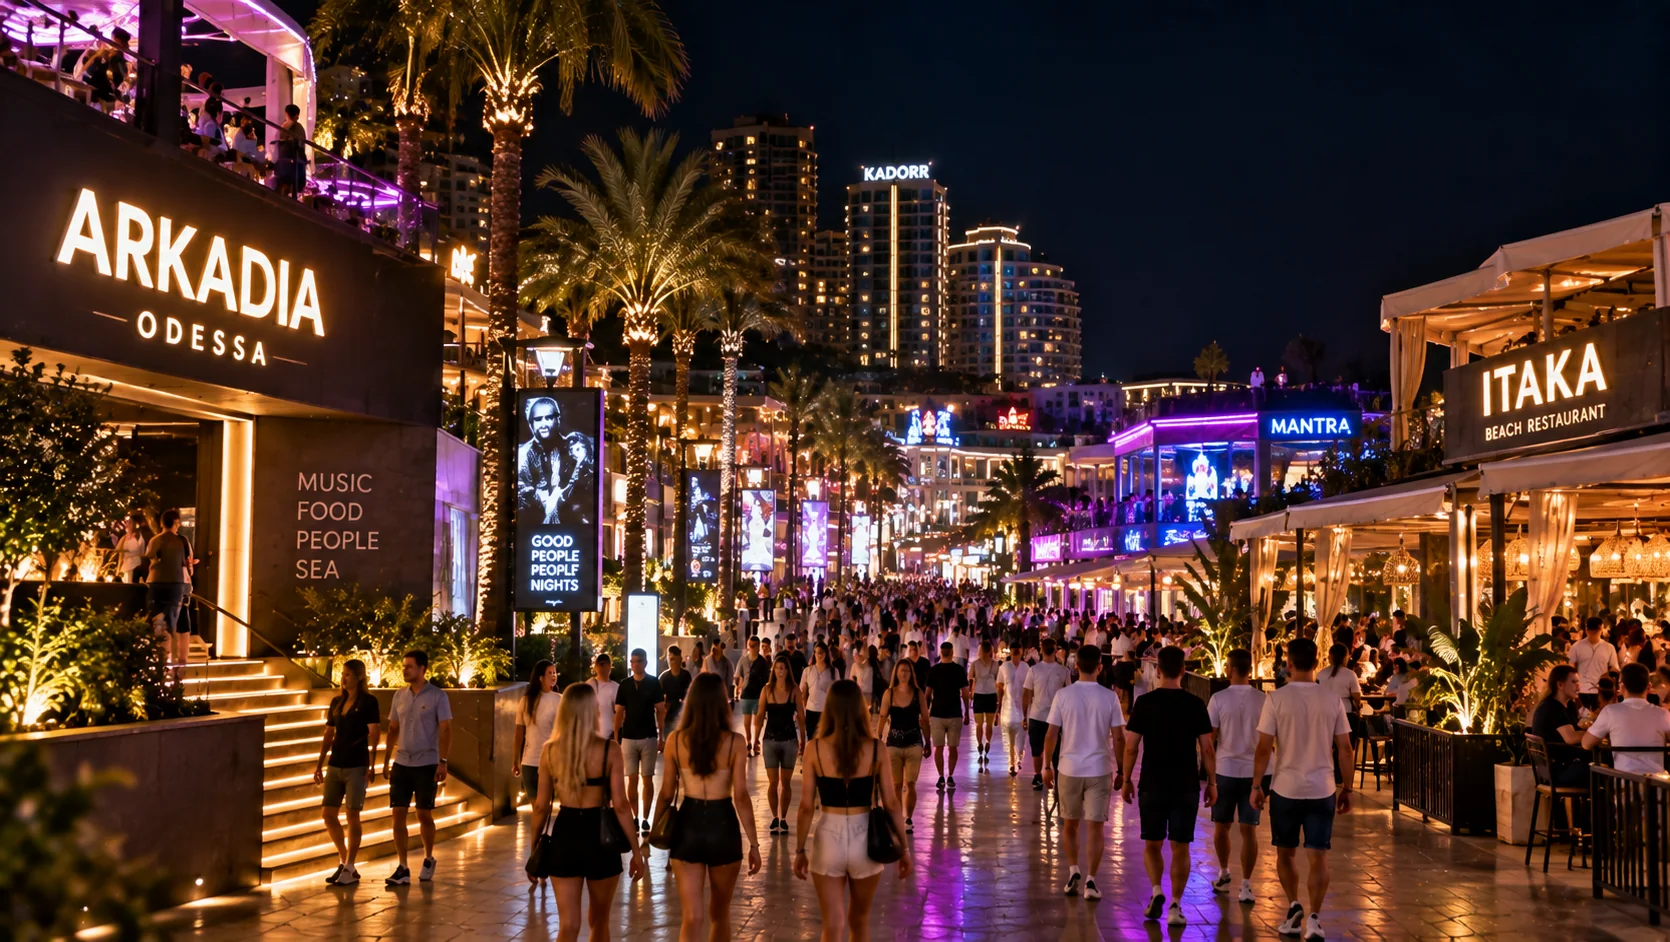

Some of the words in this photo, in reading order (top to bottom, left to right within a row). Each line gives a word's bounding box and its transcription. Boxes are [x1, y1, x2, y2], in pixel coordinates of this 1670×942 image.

[863, 164, 930, 181] KADORR
[57, 188, 325, 337] ARKADIA
[137, 311, 267, 366] ODESSA
[1483, 342, 1607, 417] ITAKA
[1271, 417, 1352, 435] MANTRA
[1485, 421, 1522, 441] BEACH
[1527, 403, 1606, 433] RESTAURANT
[297, 472, 373, 494] MUSIC
[297, 501, 363, 521] FOOD
[296, 530, 380, 550] PEOPLE
[531, 534, 574, 548] GOOD
[531, 549, 580, 562] PEOPLE
[295, 559, 340, 580] SEA
[530, 579, 579, 592] NIGHTS
